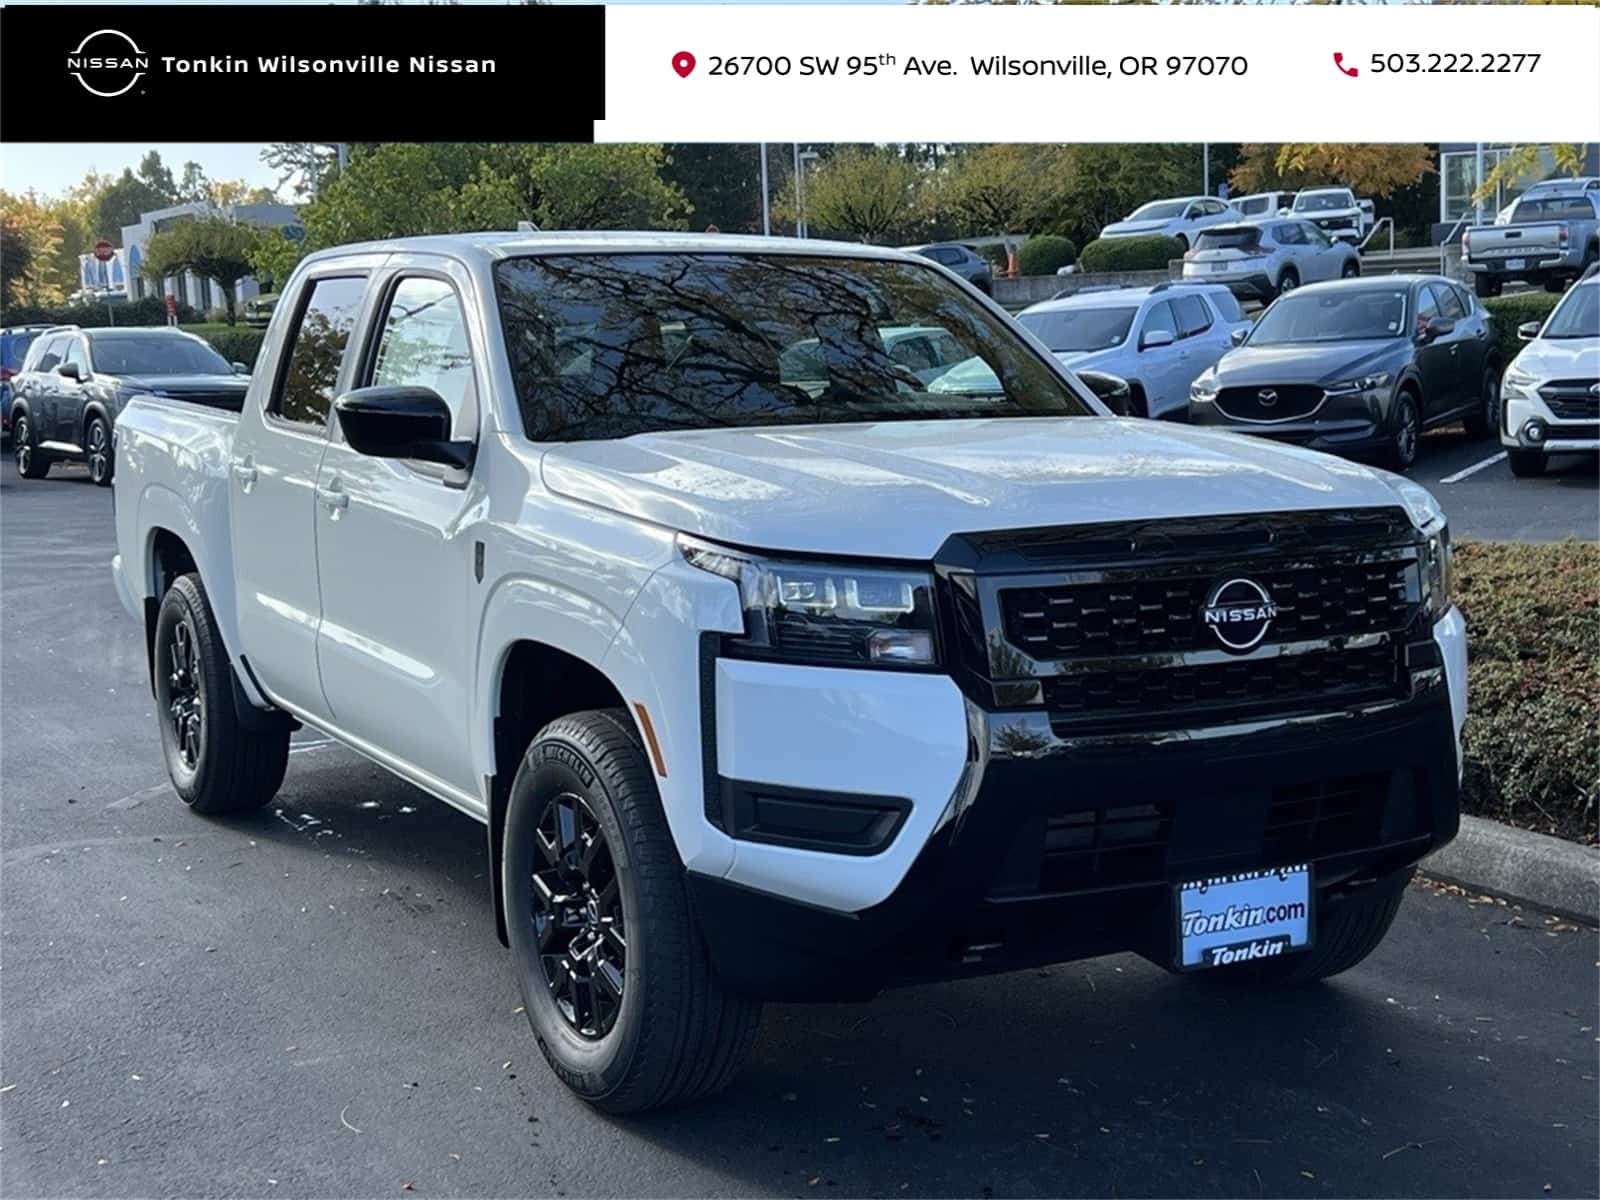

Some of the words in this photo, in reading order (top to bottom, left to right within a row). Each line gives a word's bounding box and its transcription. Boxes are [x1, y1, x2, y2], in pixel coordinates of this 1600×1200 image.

[1204, 606, 1277, 623] NISSAN
[1182, 902, 1305, 938] Tonkin.com
[1211, 939, 1284, 967] Tonkin
